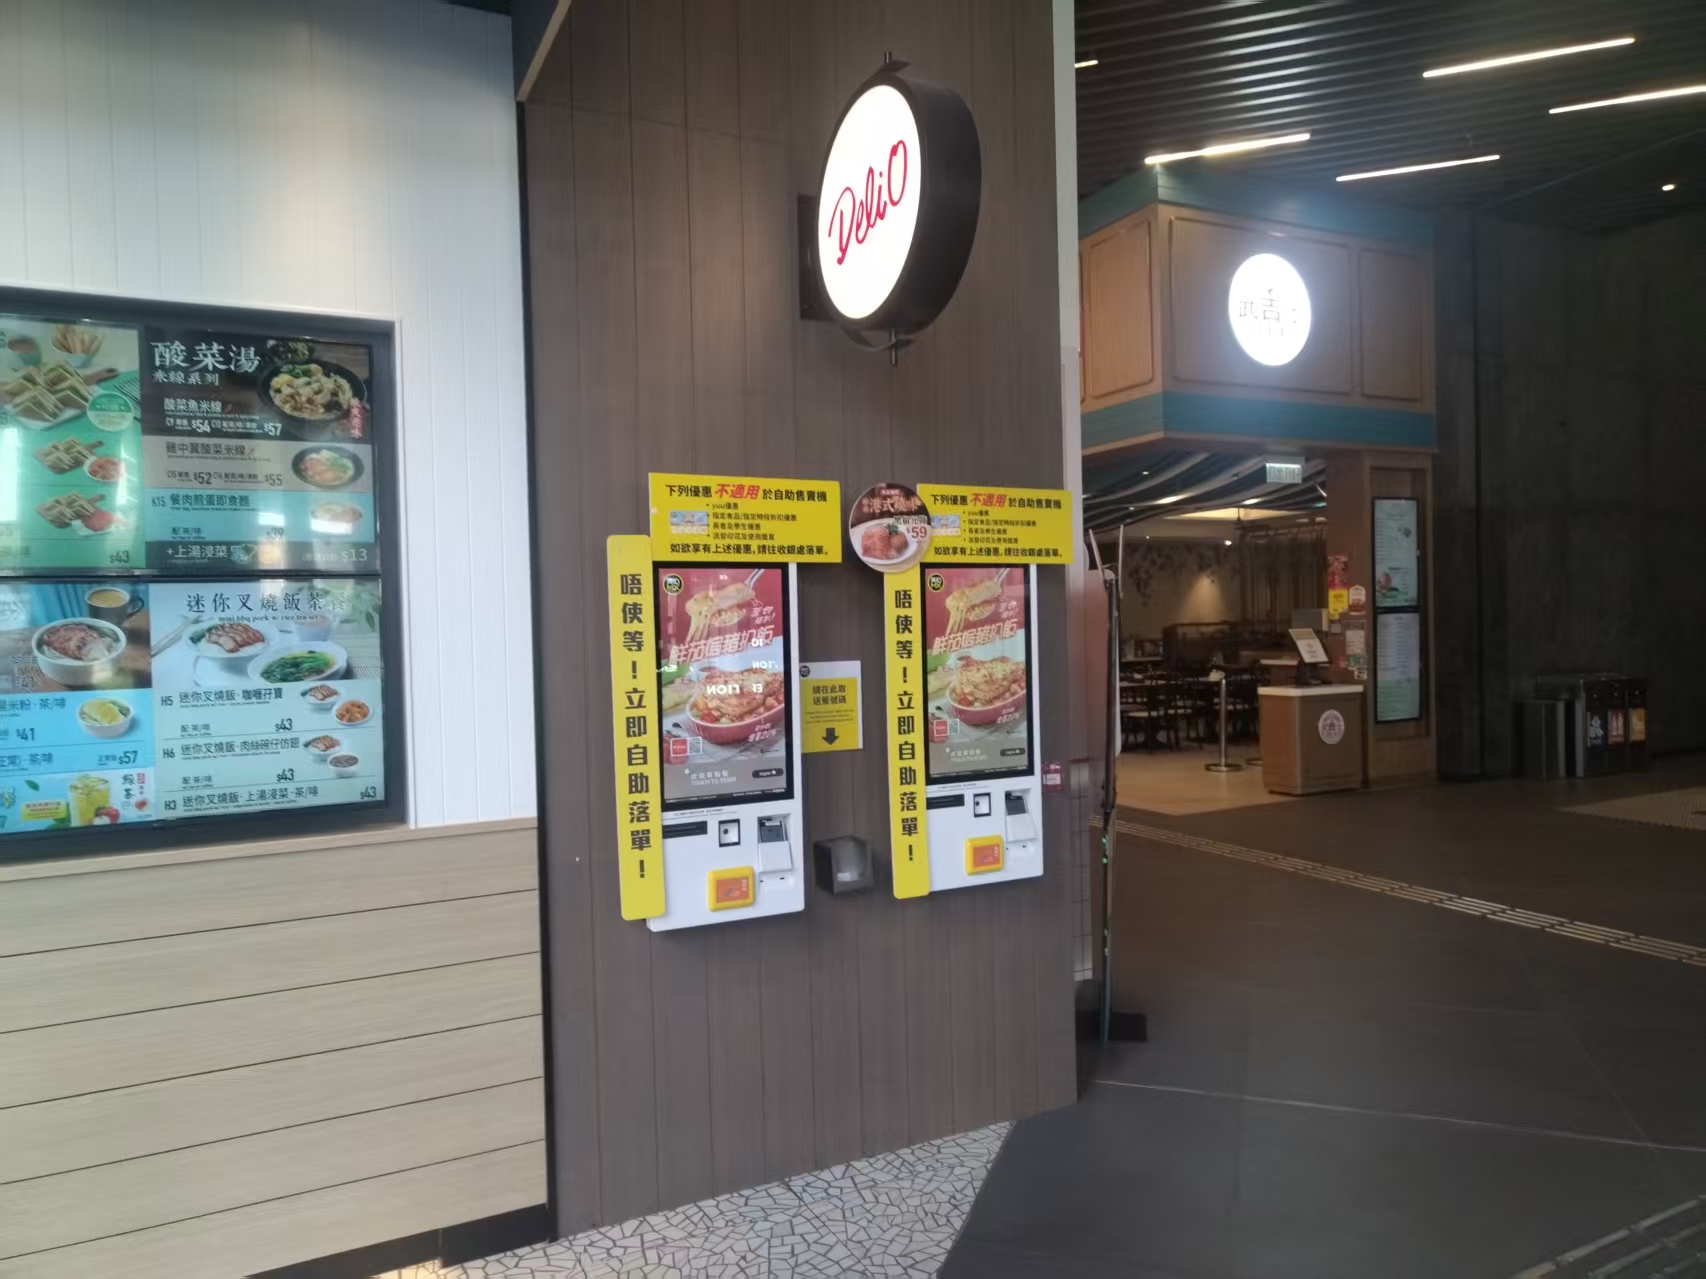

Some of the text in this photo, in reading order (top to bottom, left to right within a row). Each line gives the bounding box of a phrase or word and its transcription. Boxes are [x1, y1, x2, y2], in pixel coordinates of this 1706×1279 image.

[150, 340, 261, 374] 酸菜湯
[152, 371, 219, 386] 米線系列
[163, 397, 222, 413] 酸菜魚米線
[191, 419, 210, 433] $54
[262, 422, 281, 436] $57
[193, 472, 212, 484] $52
[264, 474, 282, 486] $55
[665, 483, 828, 502] 下列優惠 不適用 於自助售賣機
[151, 496, 165, 507] K15
[930, 493, 1063, 510] 下列優惠 不適用 於自助售賣機
[906, 526, 928, 539] $59
[109, 551, 130, 564] $43
[341, 549, 368, 561] $13
[187, 591, 346, 613] 迷你叉燒飯茶餐
[812, 684, 846, 695] 請在此取
[161, 696, 173, 706] H5
[275, 718, 293, 731] $43
[16, 727, 35, 741] $41
[118, 750, 139, 764] $57
[162, 748, 175, 758] H6
[276, 768, 295, 782] $43
[359, 786, 377, 800] $43
[164, 800, 177, 811] H3
